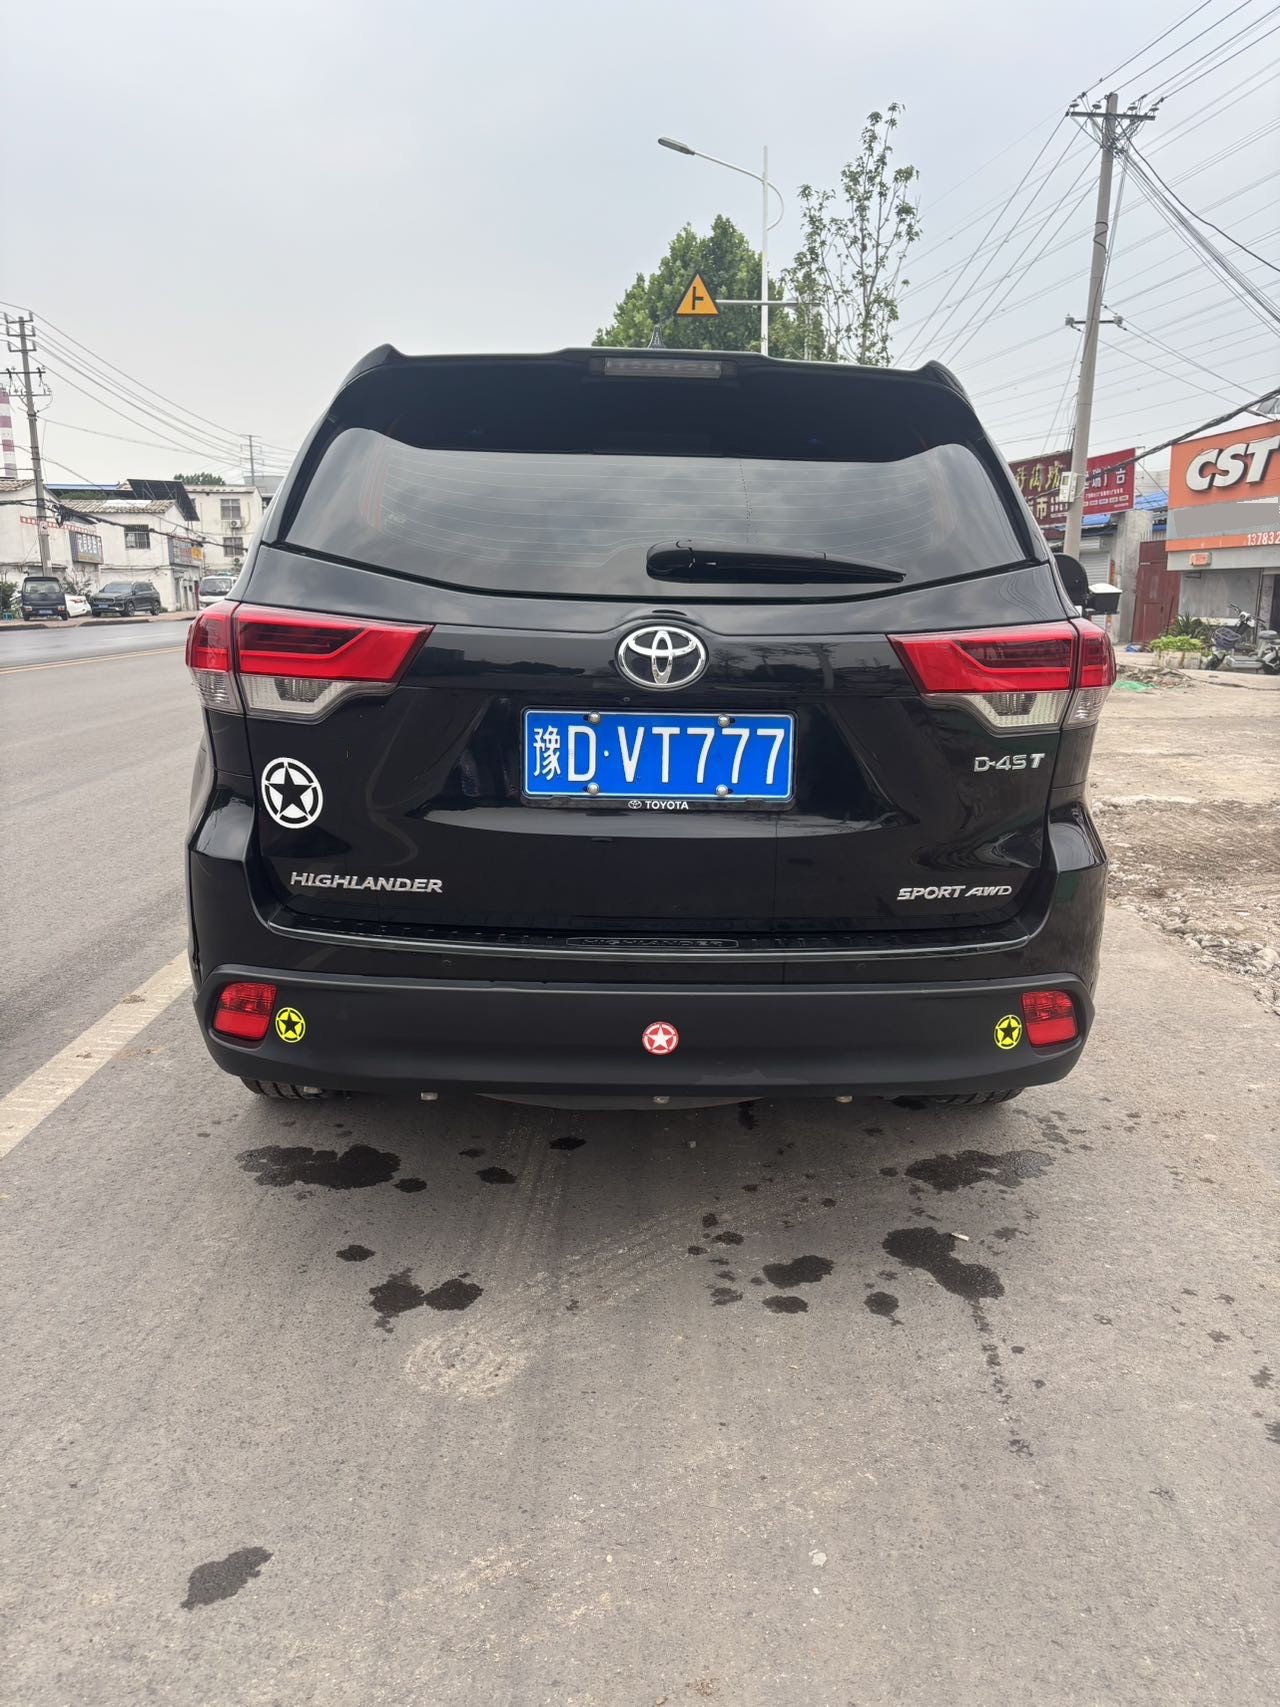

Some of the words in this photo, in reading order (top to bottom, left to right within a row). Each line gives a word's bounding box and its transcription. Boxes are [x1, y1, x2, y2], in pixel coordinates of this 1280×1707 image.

[1186, 435, 1280, 491] CST
[644, 800, 689, 811] TOYOTA
[290, 871, 443, 893] HIGHLANDER
[896, 885, 967, 901] SPORT
[965, 885, 1013, 897] AWD
